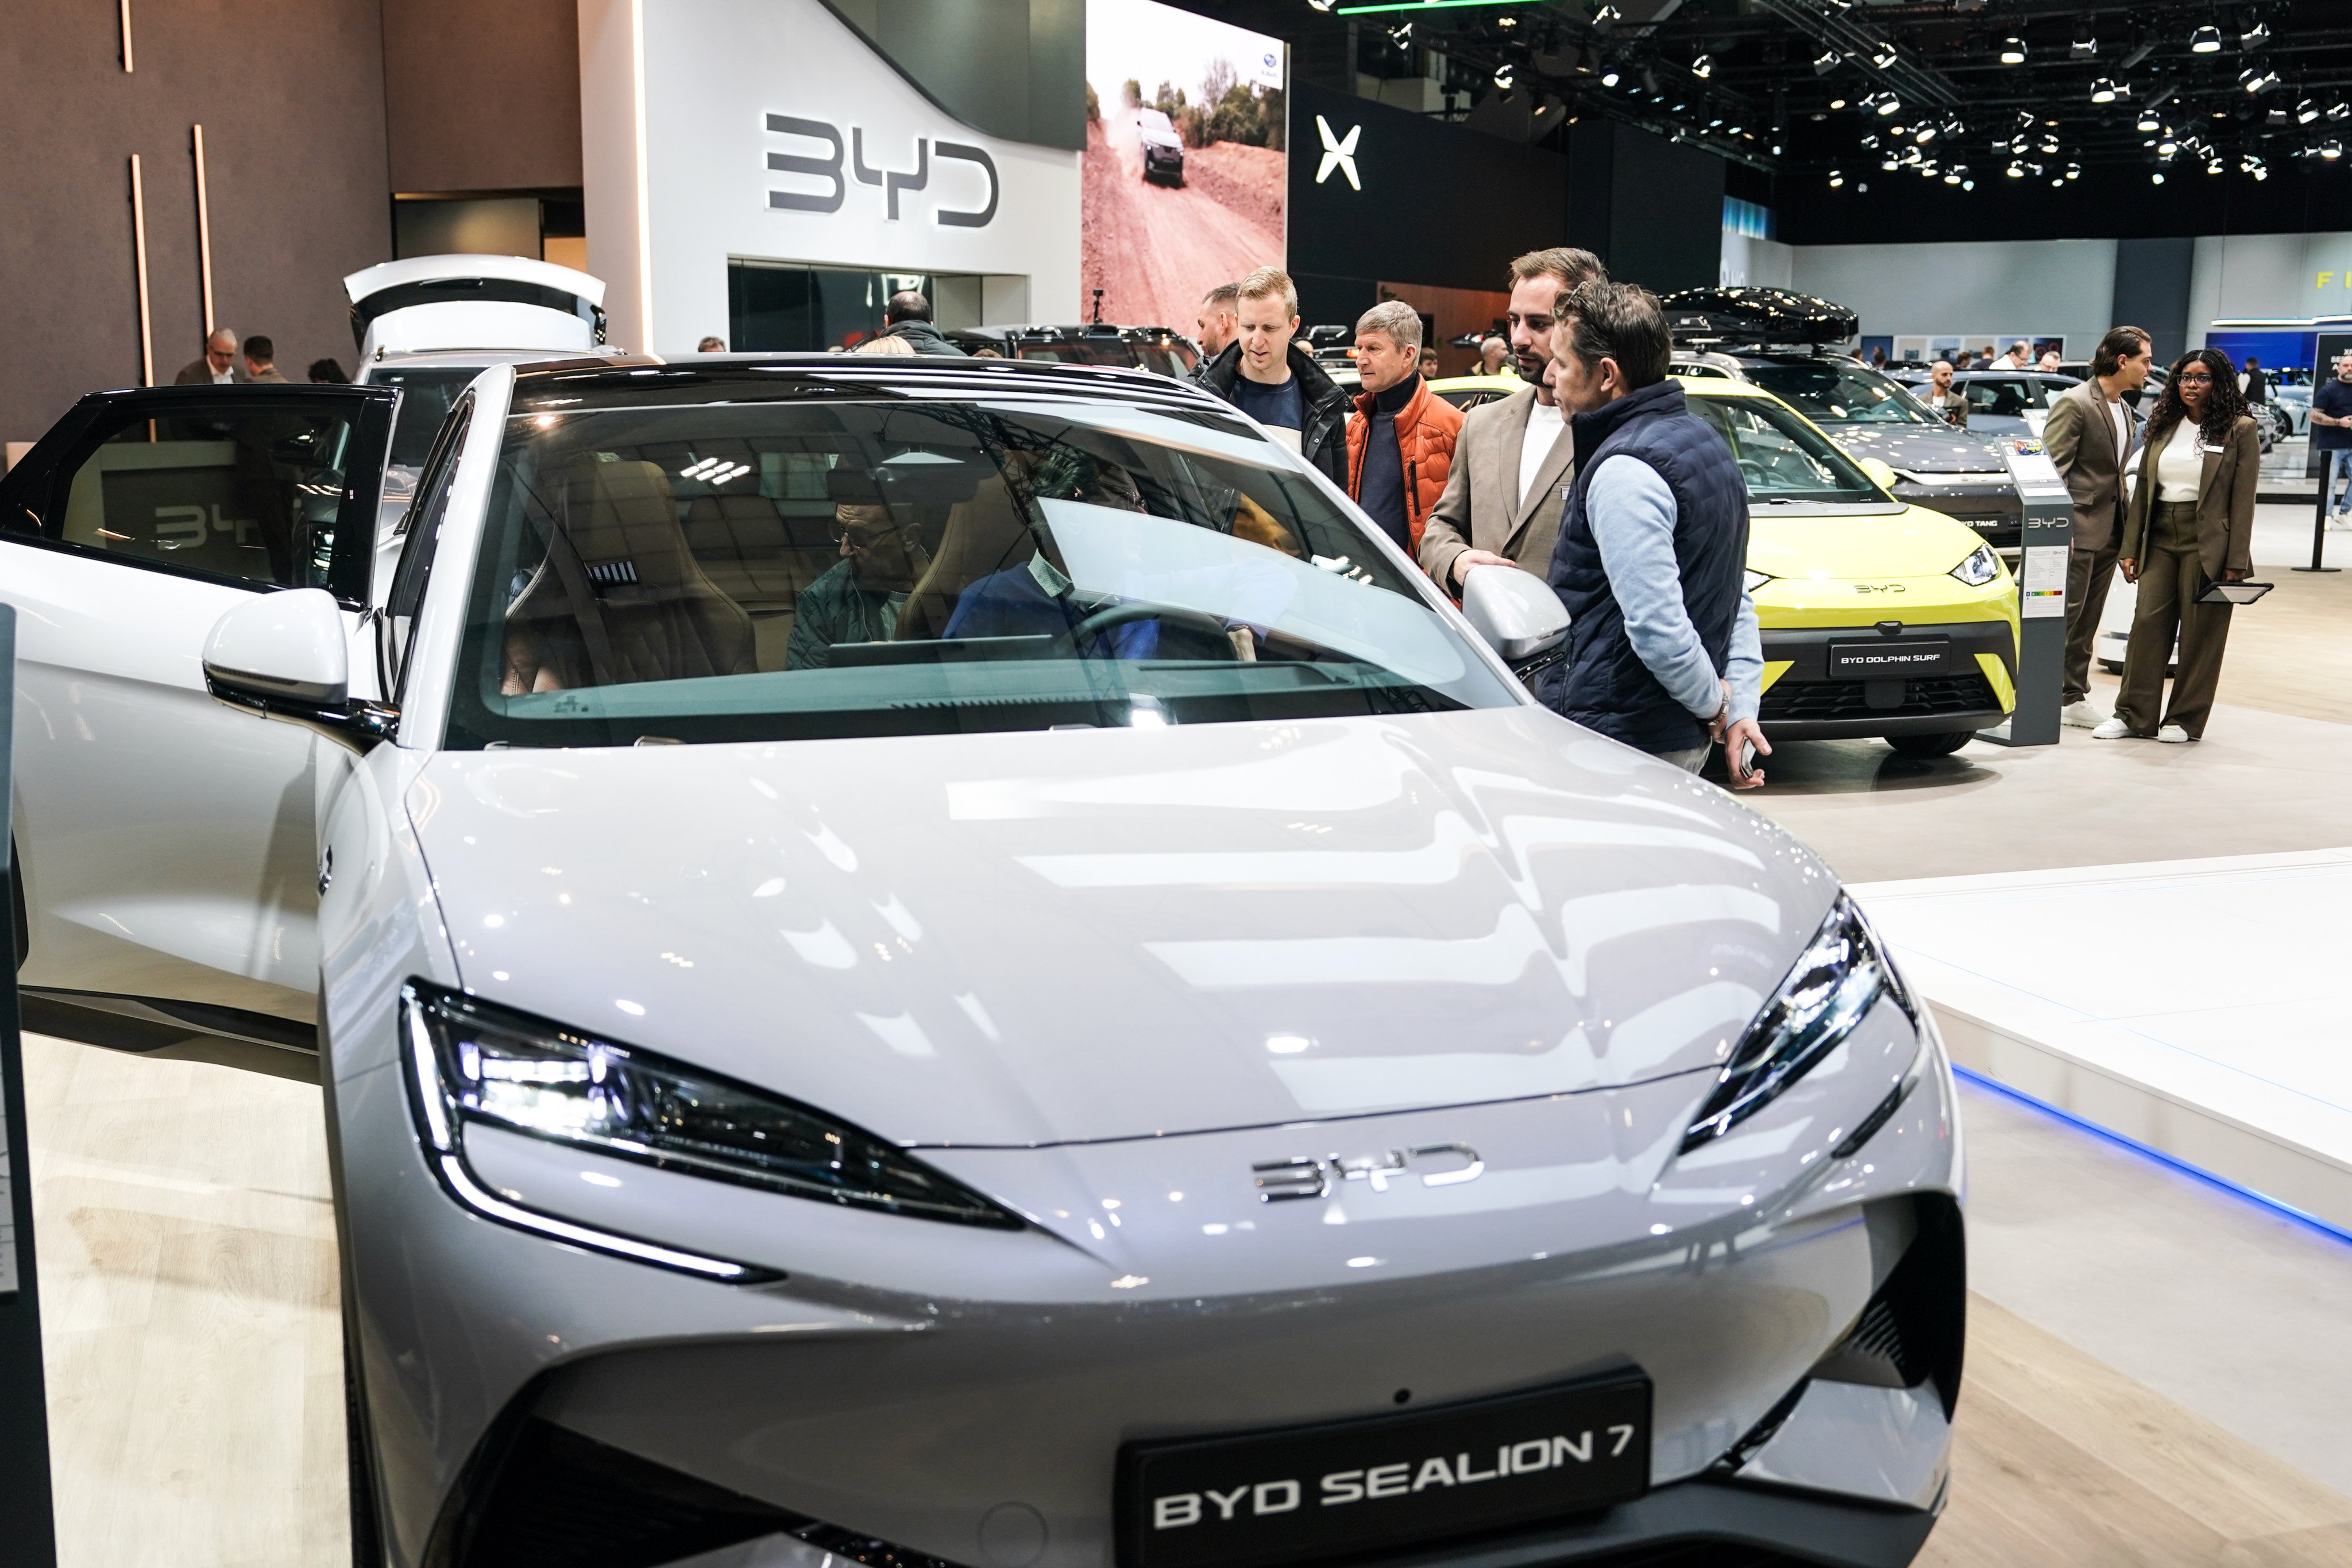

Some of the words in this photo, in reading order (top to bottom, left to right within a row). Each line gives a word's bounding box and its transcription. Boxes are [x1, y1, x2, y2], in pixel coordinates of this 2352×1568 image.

[766, 113, 999, 228] BYD
[155, 504, 260, 550] BY
[2027, 517, 2069, 528] BYD
[1853, 584, 1906, 593] BYD
[1866, 655, 1911, 663] DOLPHIN
[1913, 654, 1941, 662] SURF
[1252, 1141, 1486, 1202] BYD
[1153, 1479, 1302, 1530] BYD
[1320, 1430, 1593, 1507] SEALION
[1608, 1424, 1634, 1458] 7
